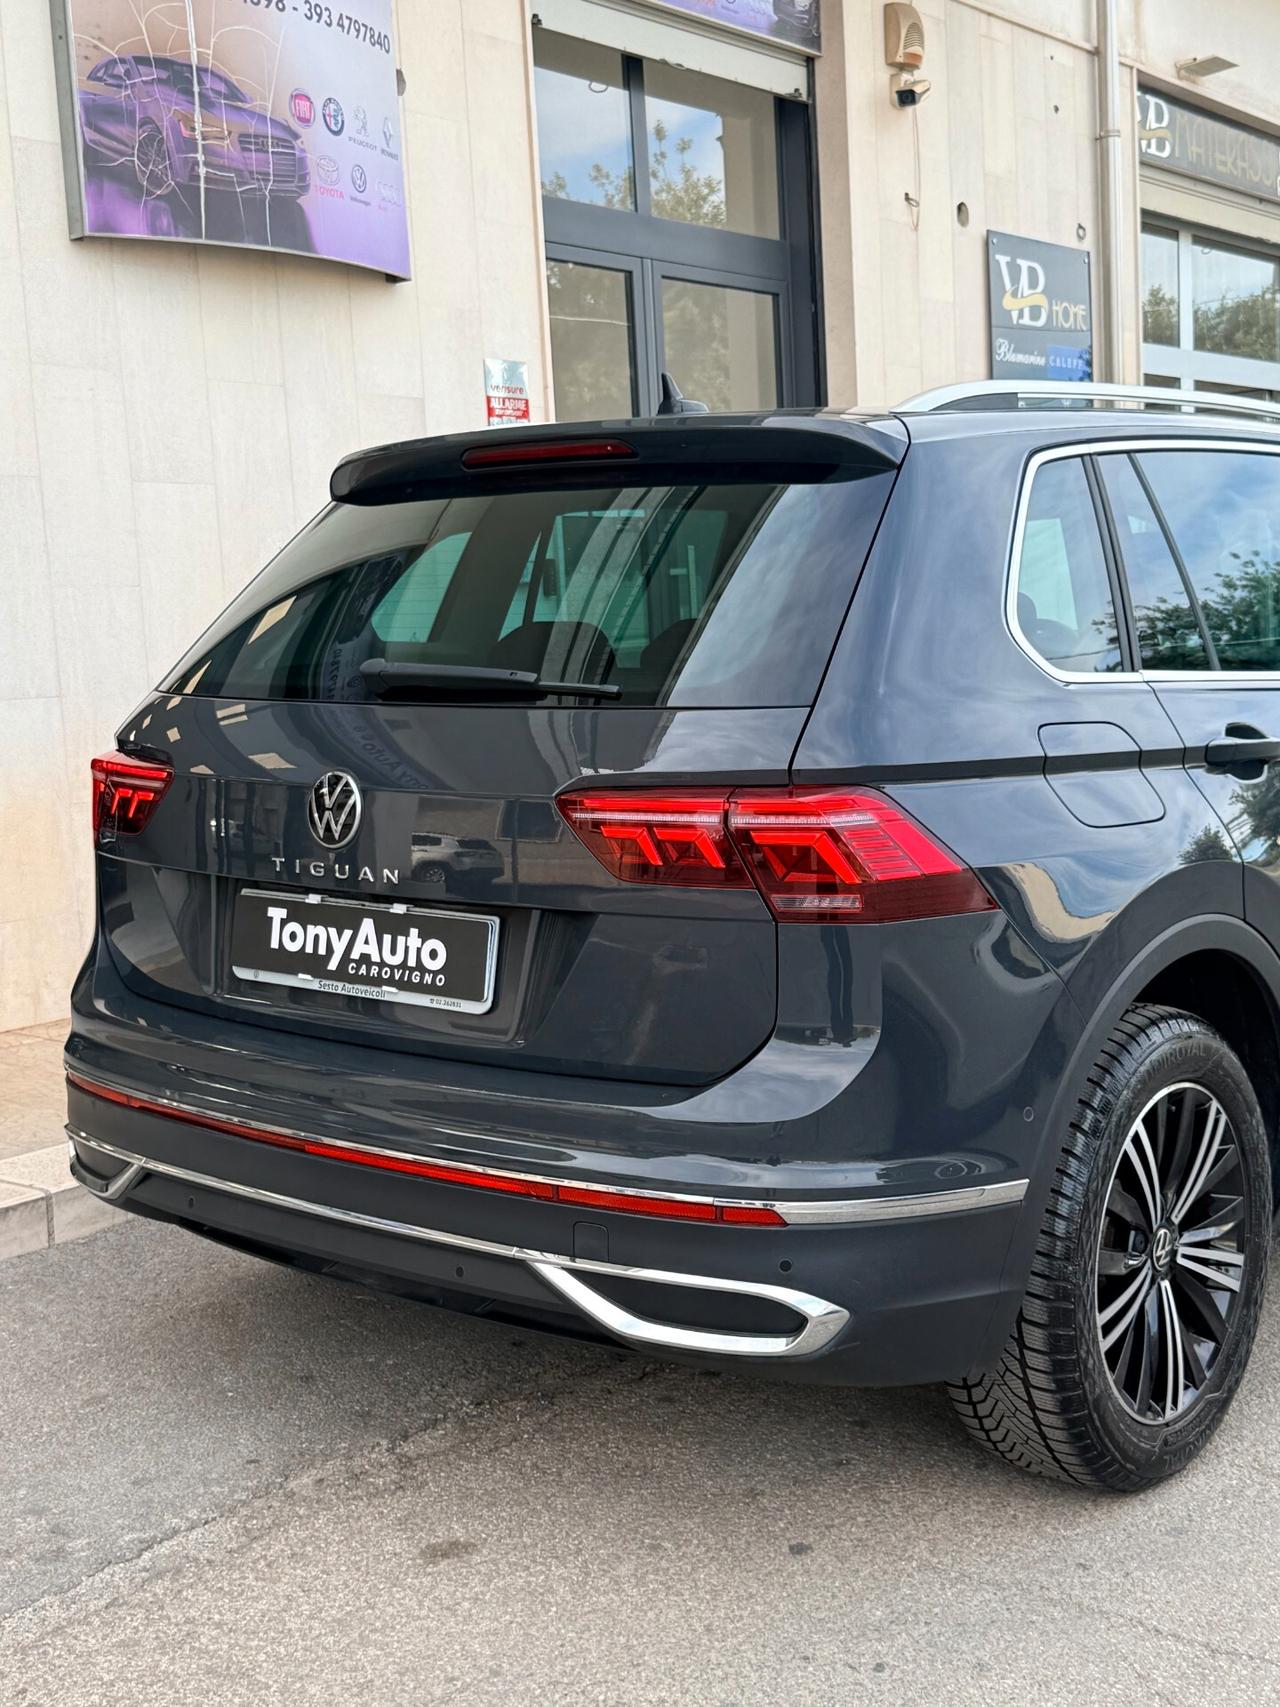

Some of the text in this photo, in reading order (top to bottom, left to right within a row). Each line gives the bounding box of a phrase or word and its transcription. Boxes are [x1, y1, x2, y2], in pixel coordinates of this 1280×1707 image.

[303, 1, 333, 27] 393
[336, 13, 391, 54] 4797840
[995, 254, 1087, 331] VB HOME
[490, 384, 525, 395] verisure
[490, 397, 528, 411] ALLARME
[271, 857, 400, 885] TIGUAN
[348, 962, 446, 986] CAROVIGNO
[317, 980, 386, 998] Sesto Autoveicoli
